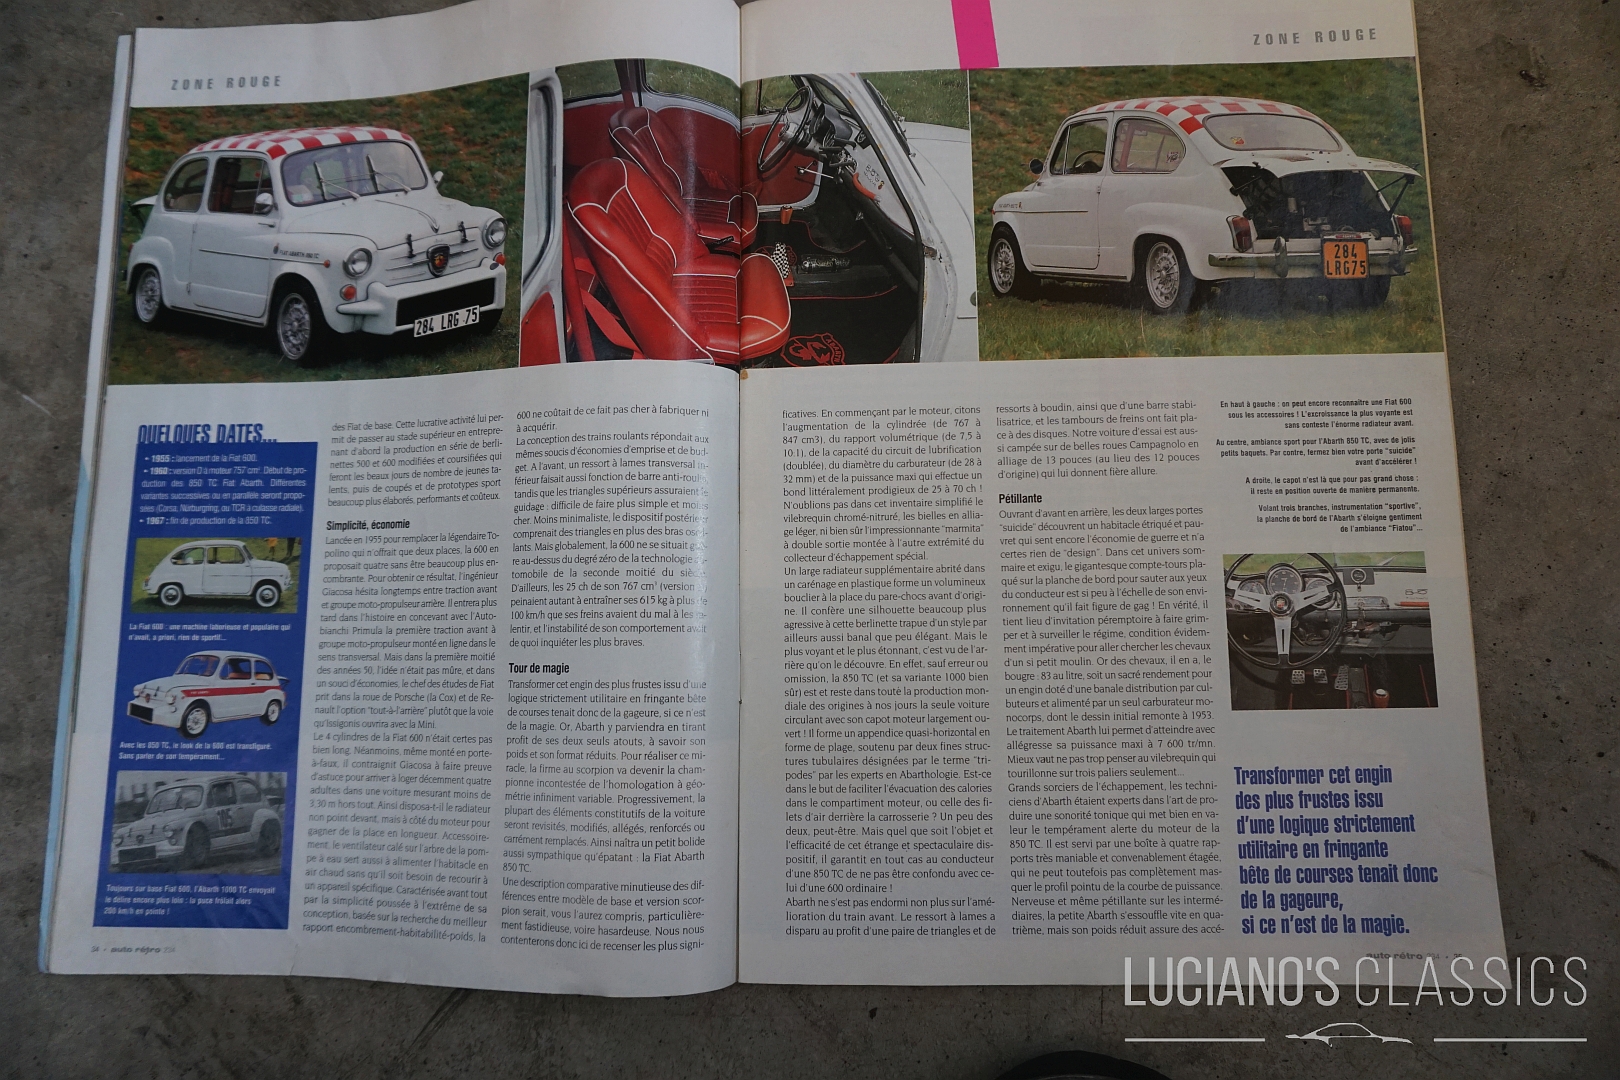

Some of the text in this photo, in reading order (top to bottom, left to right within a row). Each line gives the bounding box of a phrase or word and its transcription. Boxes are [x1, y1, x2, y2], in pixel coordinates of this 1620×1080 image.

[1253, 28, 1377, 46] ZONE ROUGE
[172, 75, 281, 90] ZONE ROUGE
[1334, 244, 1357, 259] 284
[416, 307, 477, 335] 284 LRG 75
[138, 424, 211, 443] QUELQUES
[398, 456, 435, 466] modifiées
[447, 453, 487, 463] coursifiées
[490, 452, 502, 461] qui
[998, 466, 1157, 480] d'origine) qui lui donnent fière allure.
[1285, 488, 1310, 496] position
[1378, 486, 1419, 494] permanente.
[999, 494, 1042, 504] Pétillante
[1298, 504, 1329, 512] branches,
[190, 516, 226, 526] production
[326, 519, 410, 531] Simplicité, économie
[784, 550, 928, 562] collecteur d'échappement spécial.
[510, 638, 644, 649] de quoi inquiéter les plus braves.
[509, 662, 570, 675] Tour de magie
[1008, 768, 1057, 778] tourillonne
[1076, 768, 1095, 777] trois
[1098, 767, 1127, 778] paliers
[1234, 765, 1392, 786] Transformer cet engin
[1235, 790, 1383, 812] des plus frustes issu
[1237, 814, 1415, 836] d'une logique strictement
[504, 834, 705, 849] carrément remplacés. Ainsi naîtra un petit bolide
[1238, 840, 1388, 860] utilitaire en fringante
[1240, 864, 1438, 884] bête de courses tenait donc
[1241, 890, 1343, 912] de la gageure,
[1242, 914, 1410, 936] si ce n'est de la magie.
[303, 924, 334, 933] rapport
[478, 933, 486, 942] la
[135, 946, 161, 955] rétro
